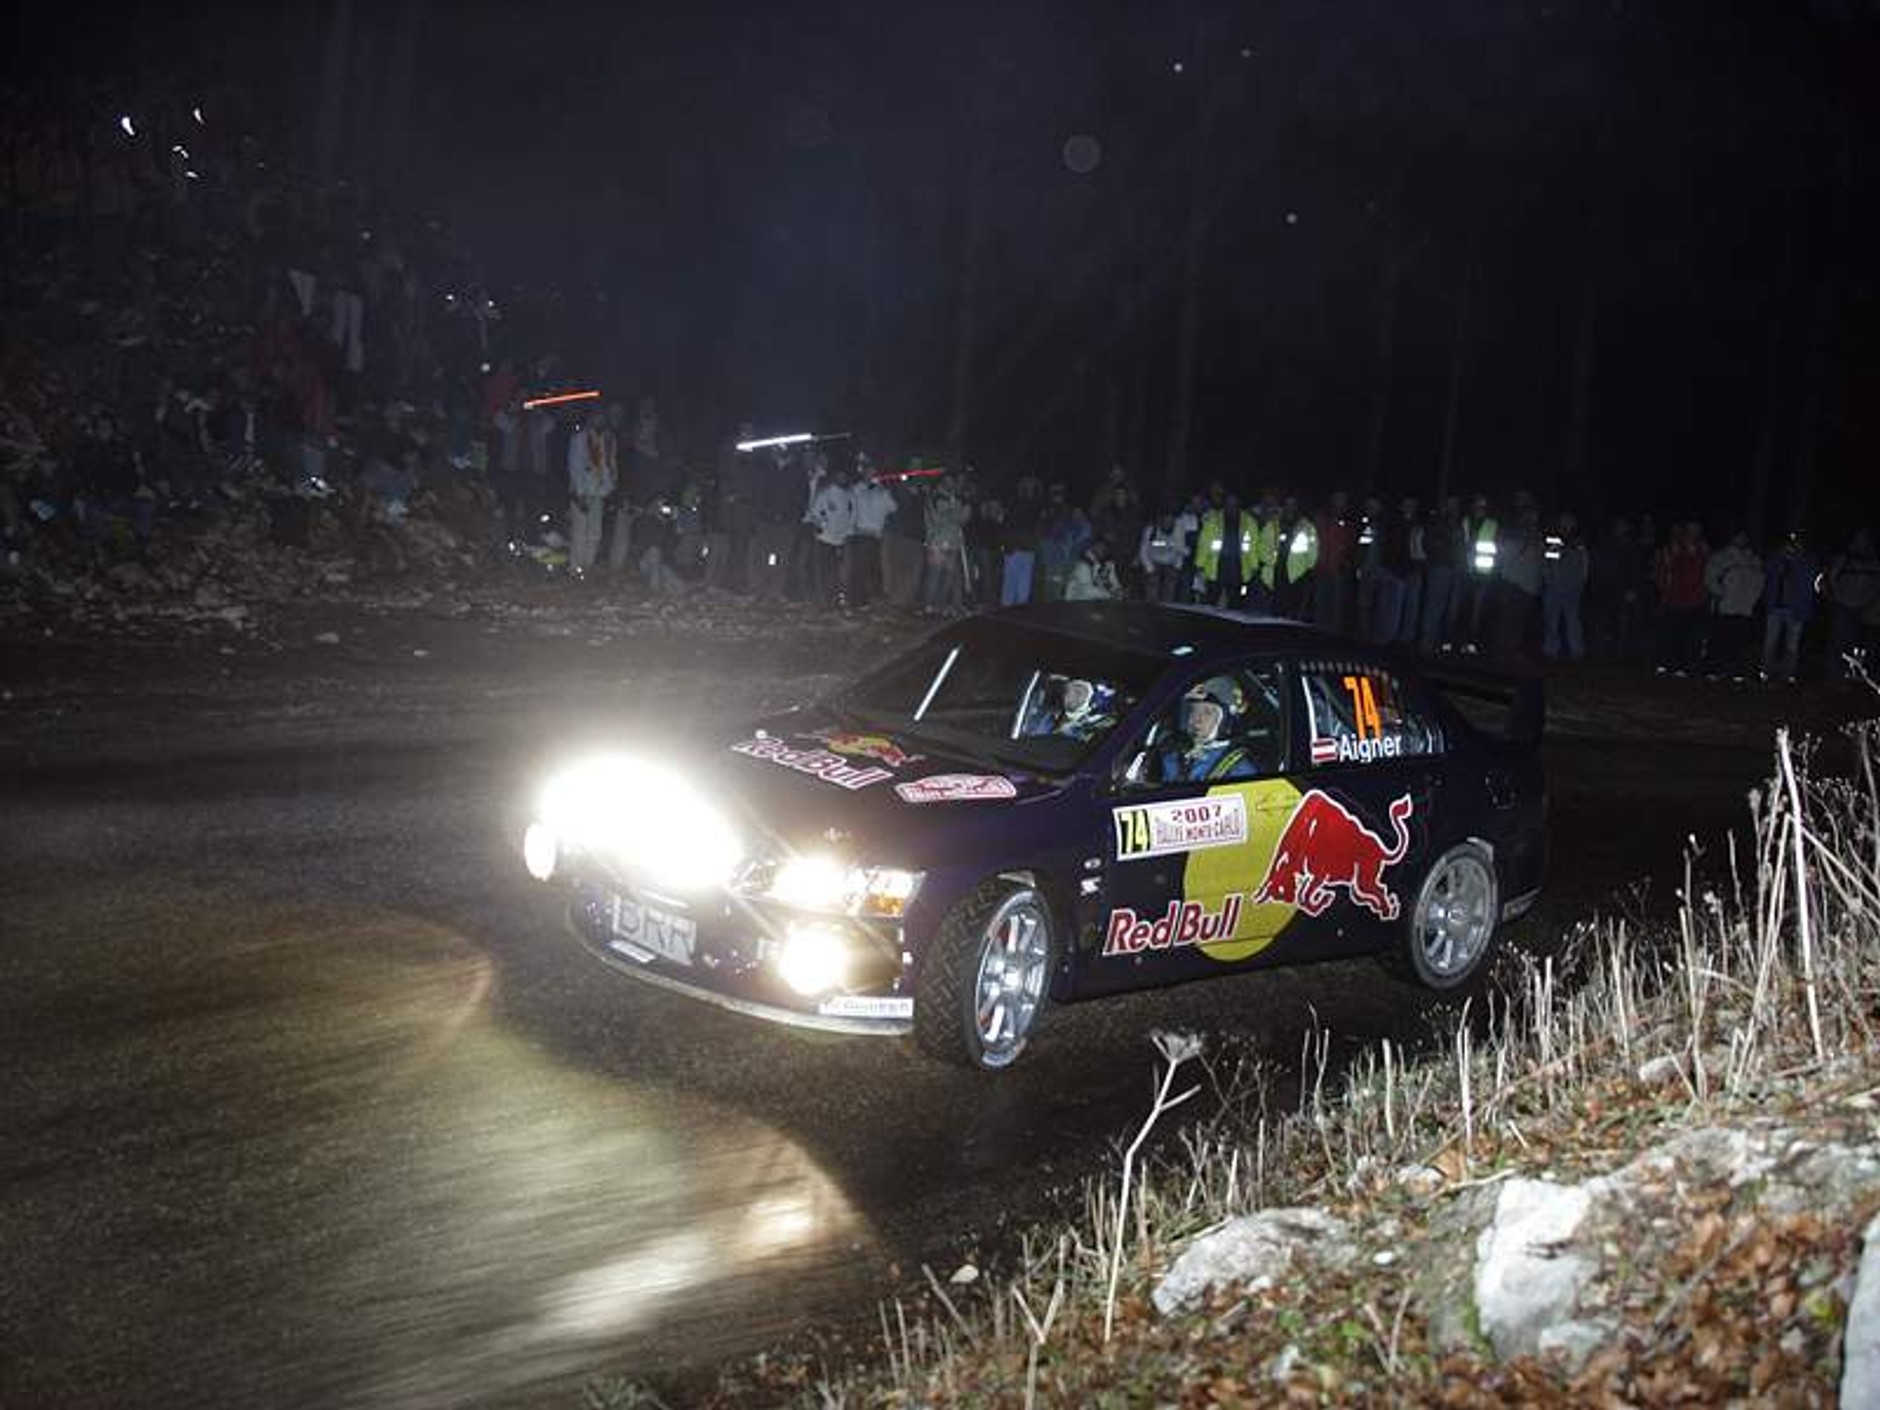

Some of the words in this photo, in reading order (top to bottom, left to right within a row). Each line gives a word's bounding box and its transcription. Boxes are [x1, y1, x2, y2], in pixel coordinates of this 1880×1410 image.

[1343, 676, 1383, 740] 74
[1339, 733, 1403, 763] Aigner
[1119, 810, 1150, 855] 74
[1170, 804, 1222, 824] 2007
